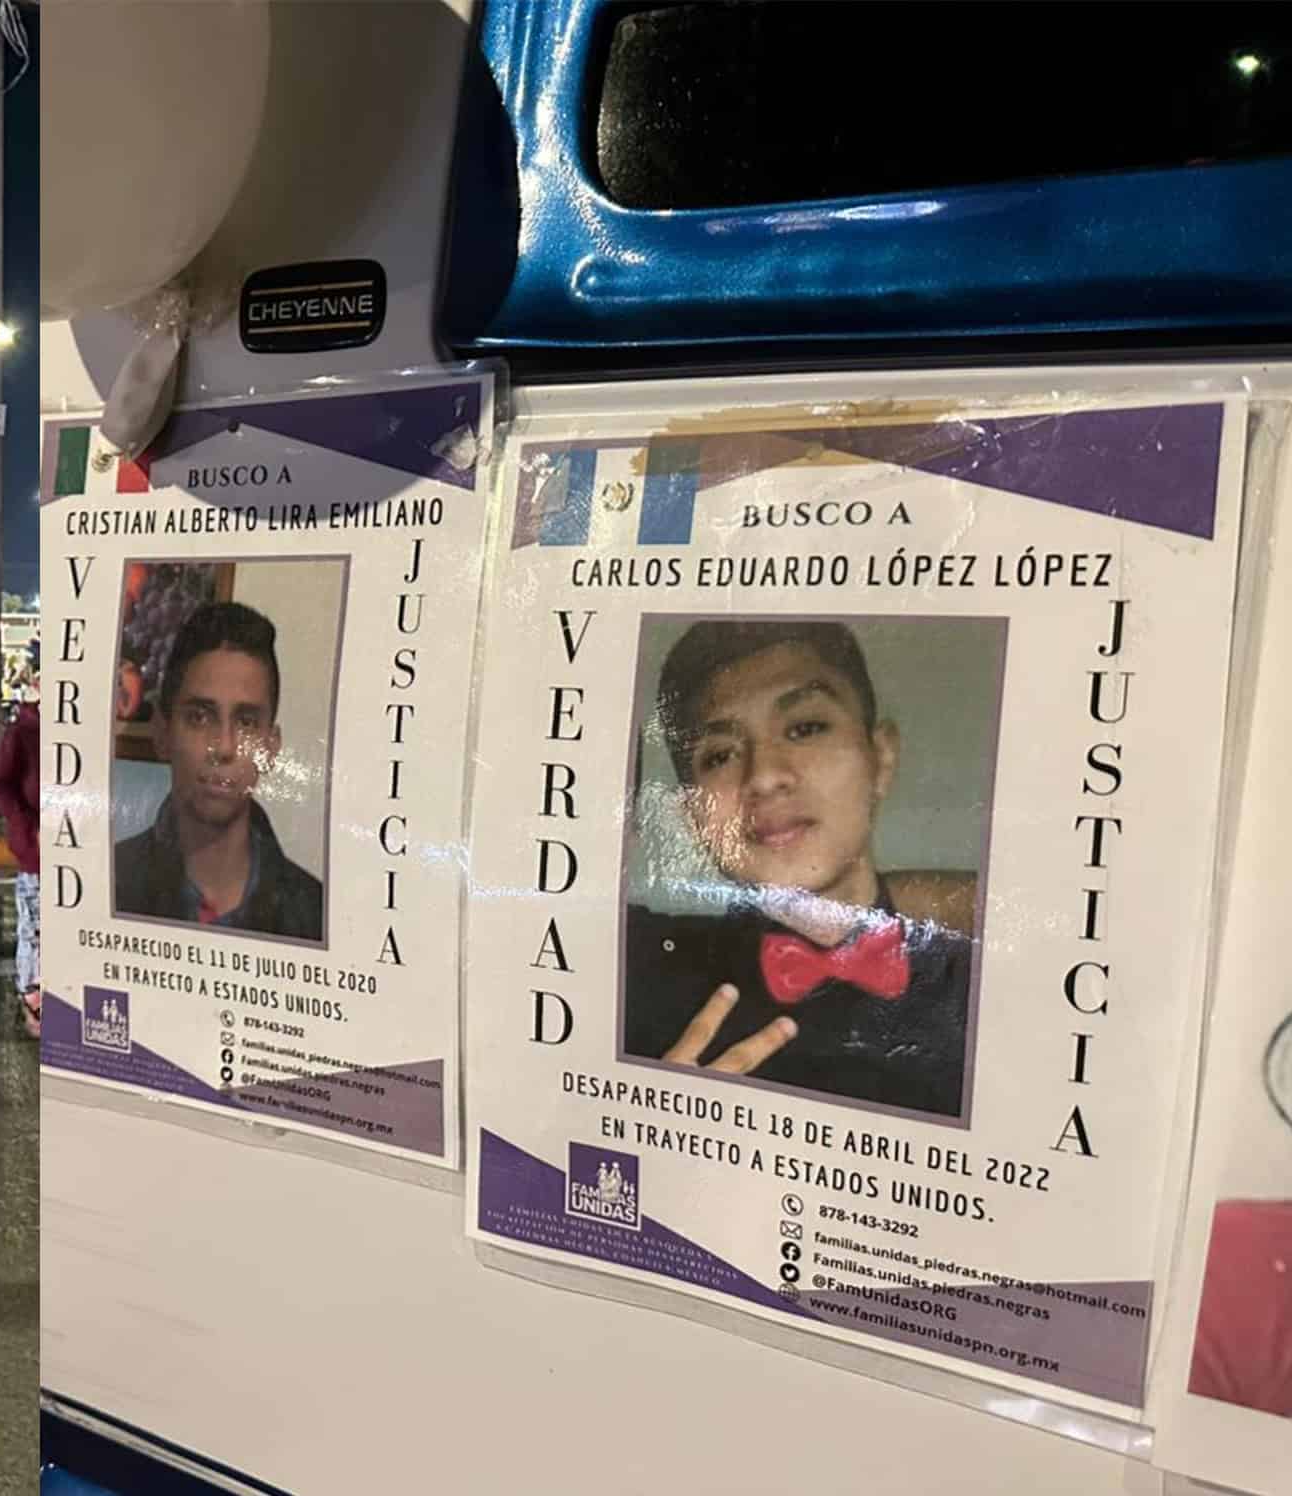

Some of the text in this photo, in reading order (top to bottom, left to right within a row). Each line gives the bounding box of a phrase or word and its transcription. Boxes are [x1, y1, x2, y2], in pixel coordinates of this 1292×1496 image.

[248, 294, 373, 321] CHEYENNE
[188, 464, 292, 489] BUSCO A
[66, 497, 444, 536] CRISTIAN ALBERTO LIRA EMILIANO
[742, 501, 912, 528] BUSCO A
[571, 546, 1112, 587] CARLOS EDUARDO LÓPEZ LÓPEZ
[54, 556, 96, 909] VERDAD
[375, 538, 425, 967] JUSTICIA
[529, 609, 597, 1047] VERDAD
[1048, 600, 1136, 1159] JUSTICIA
[78, 928, 378, 996] DESAPARECIDO EL 11 DE JULIO DEL 2020
[103, 962, 350, 1023] EN TRAYECTO A ESTADOS UNIDOS.
[243, 1016, 306, 1039] 878-143-3292
[563, 1071, 1051, 1192] DESAPARECIDO EL 18 DE ABRIL DEL 2022
[601, 1115, 996, 1224] EN TRAYECTO A ESTADOS UNIDOS.
[571, 1193, 637, 1224] UNIDAS
[818, 1204, 920, 1240] 878-143-3292
[812, 1273, 958, 1323] @FamUnidasORG
[813, 1252, 1052, 1322] Familias.unidas.piedras.negras
[814, 1230, 1148, 1320] familias.unidas_piedras.negras@hotmail.com
[809, 1296, 1061, 1375] www.familiasunidaspn.org.mx
